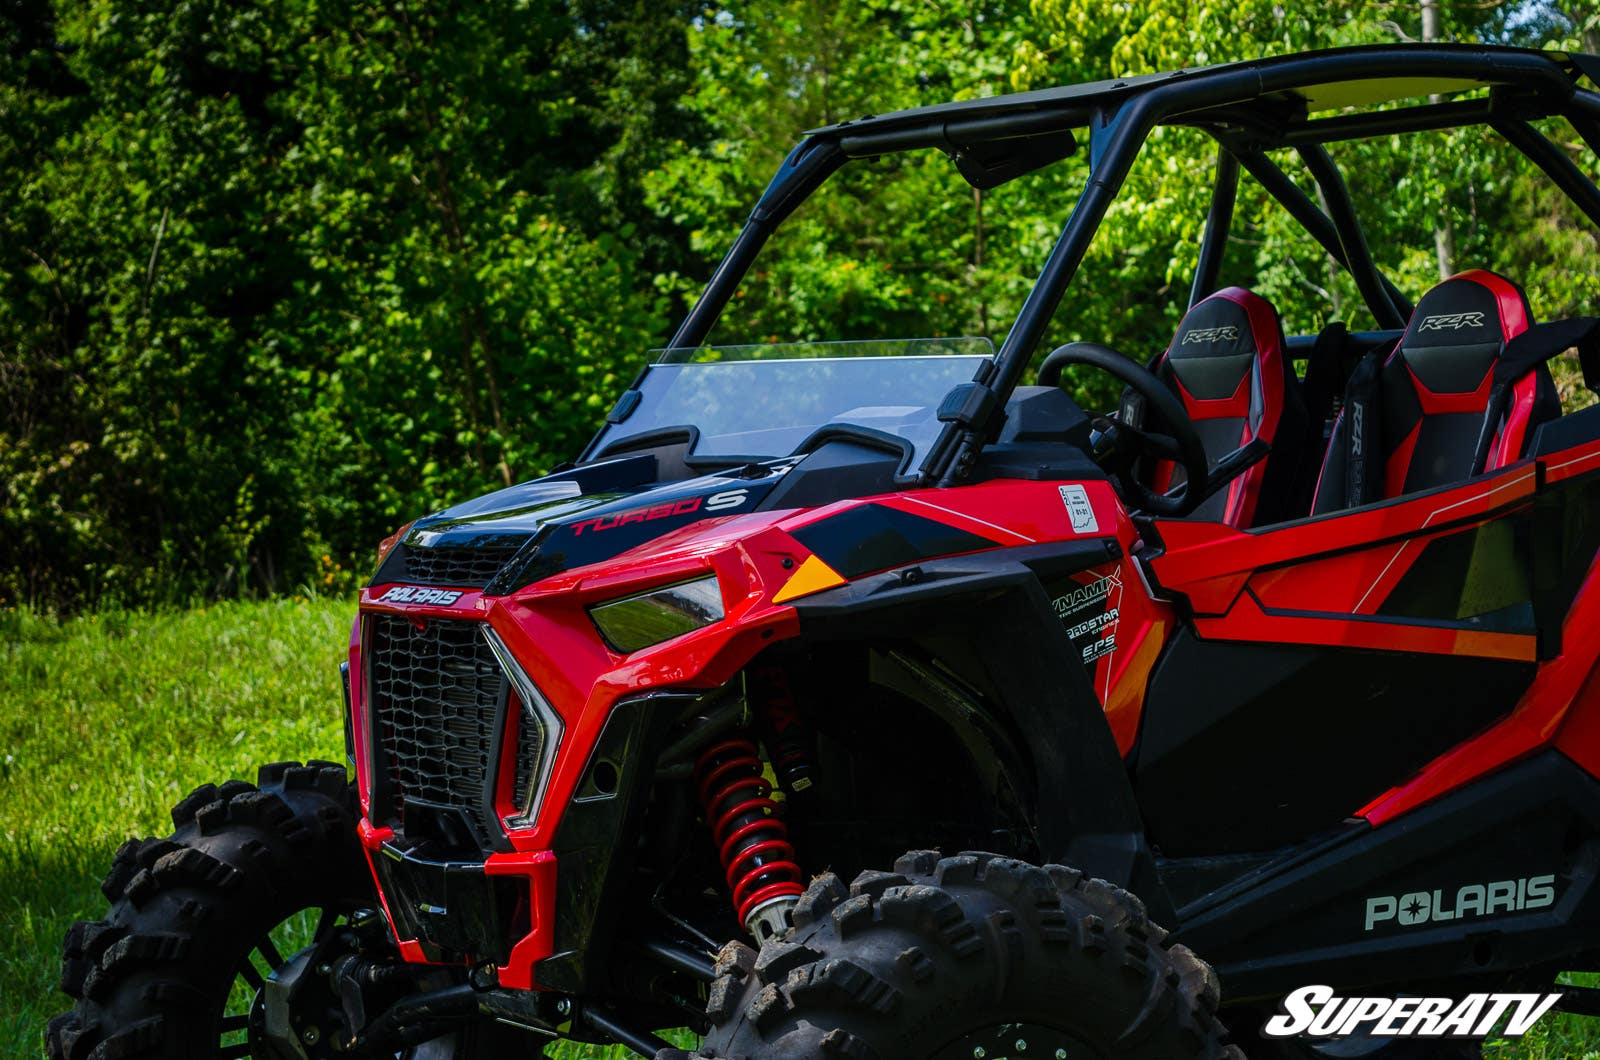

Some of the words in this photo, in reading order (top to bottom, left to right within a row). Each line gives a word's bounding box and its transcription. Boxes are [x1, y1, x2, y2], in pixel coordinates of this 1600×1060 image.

[1418, 312, 1485, 333] RZR
[1181, 326, 1238, 345] RZR
[1352, 401, 1364, 455] RZR
[569, 497, 702, 536] TURBO
[705, 488, 749, 511] S
[378, 586, 465, 606] POLARIS
[1082, 634, 1115, 657] EPS
[1365, 874, 1555, 931] POLARIS
